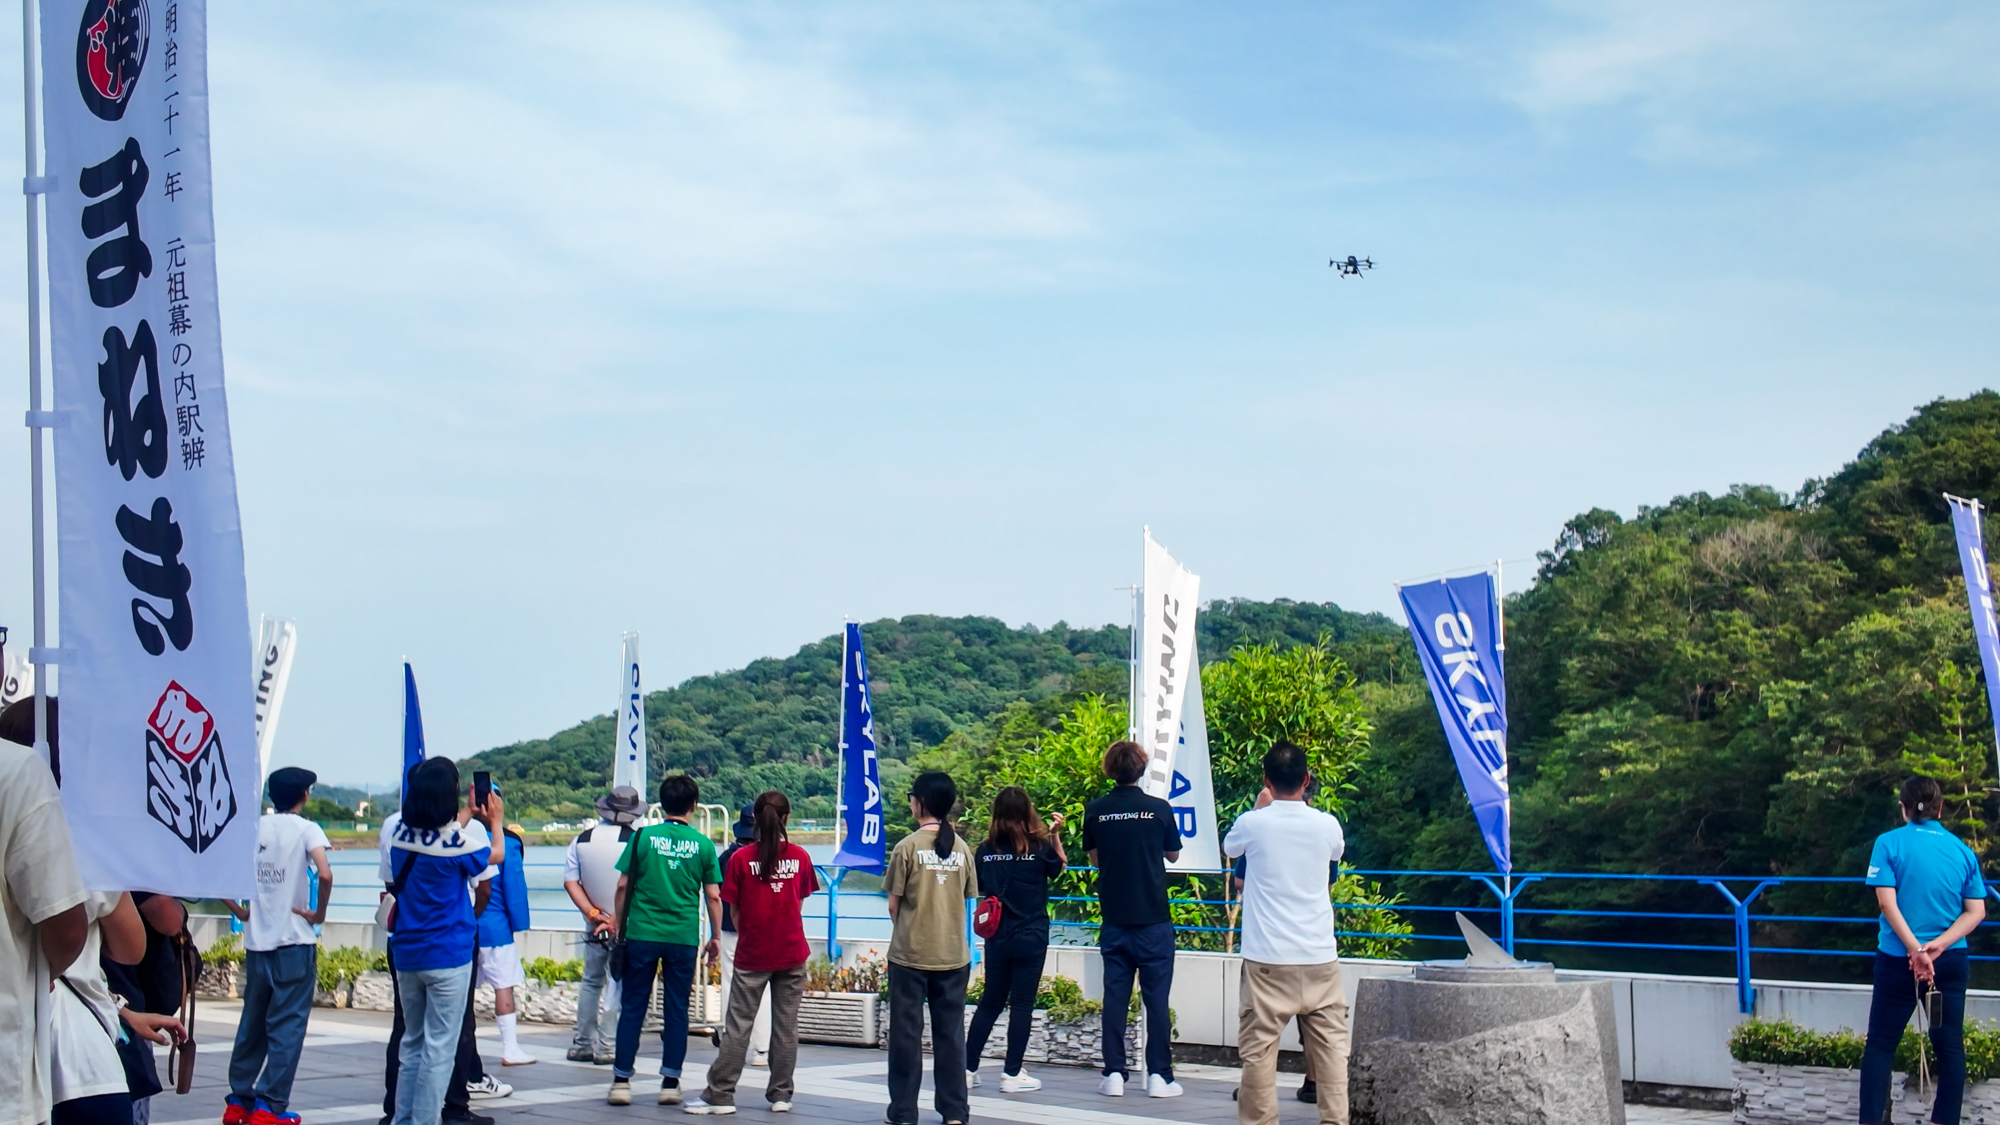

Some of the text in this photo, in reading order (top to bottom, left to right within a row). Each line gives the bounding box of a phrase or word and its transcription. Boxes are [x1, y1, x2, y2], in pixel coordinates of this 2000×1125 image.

[164, 0, 183, 203] 明治二十一年
[79, 136, 194, 657] まねき
[855, 651, 880, 845] SKYLAB
[1098, 812, 1139, 822] SKYTRYING
